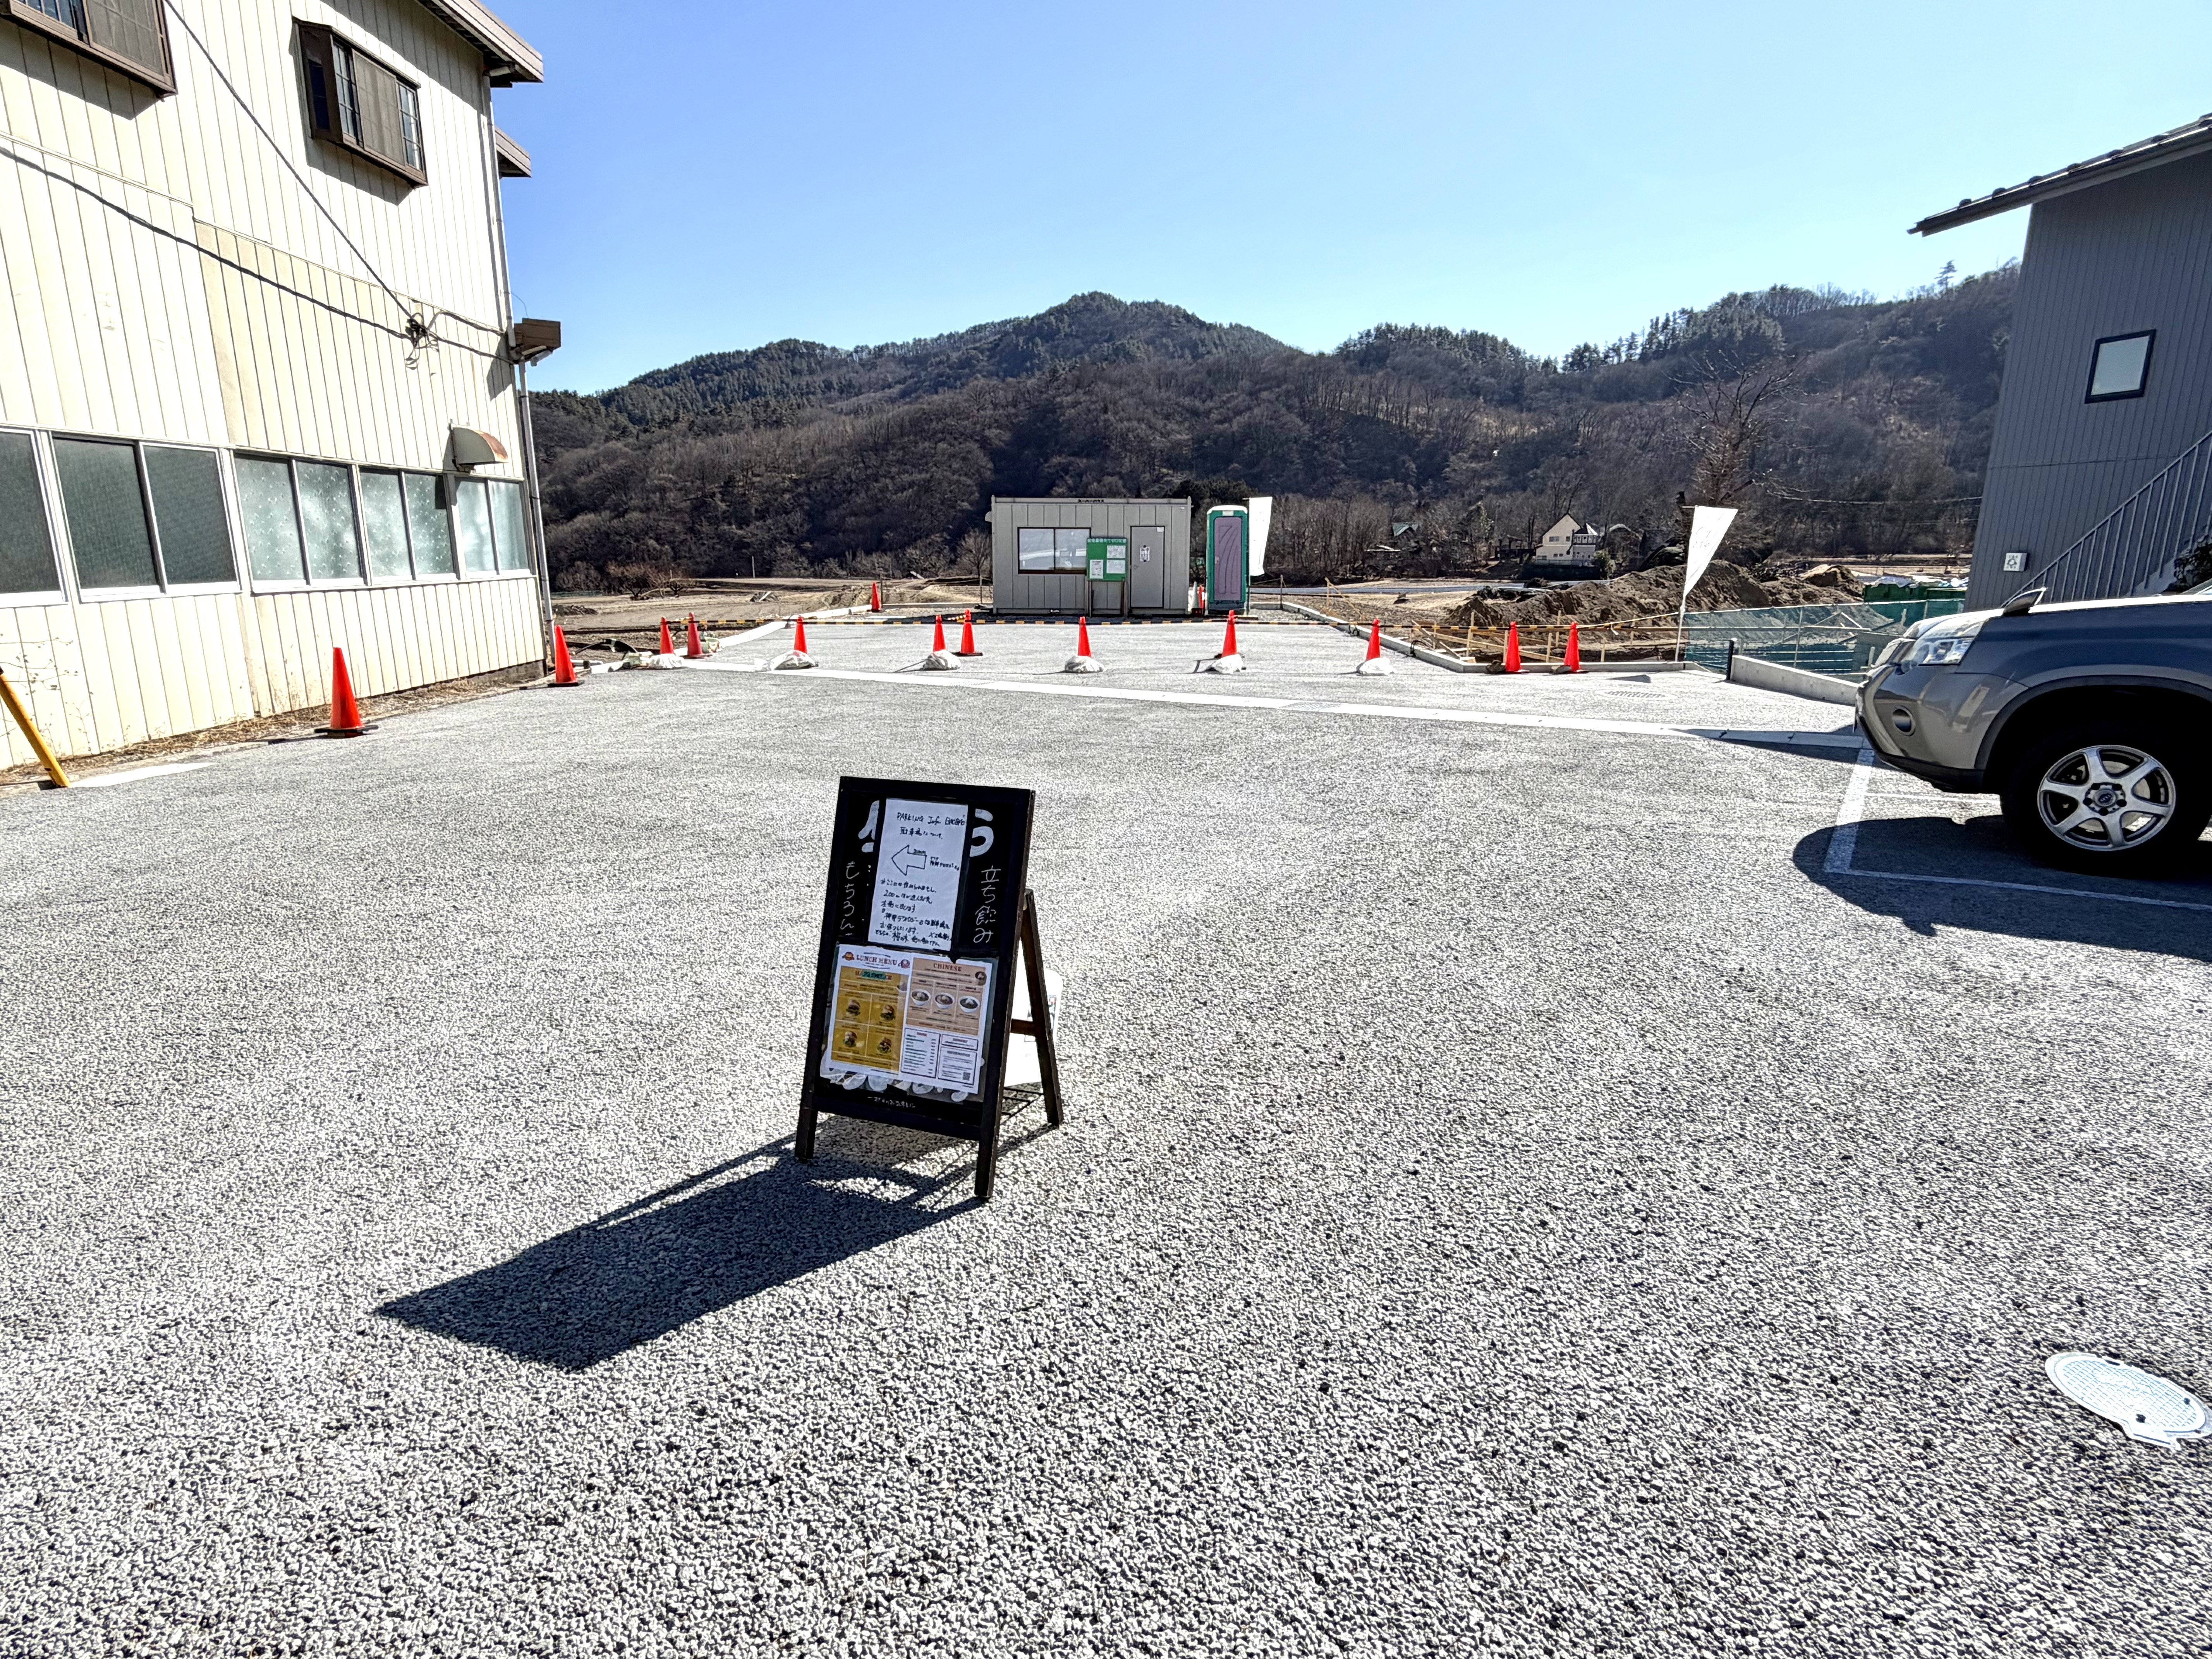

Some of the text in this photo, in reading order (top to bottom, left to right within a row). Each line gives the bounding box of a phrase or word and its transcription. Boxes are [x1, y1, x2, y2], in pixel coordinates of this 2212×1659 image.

[973, 865, 1001, 943] 立ち飲み
[856, 954, 877, 963] LUNCH
[933, 963, 962, 972] CHINESE
